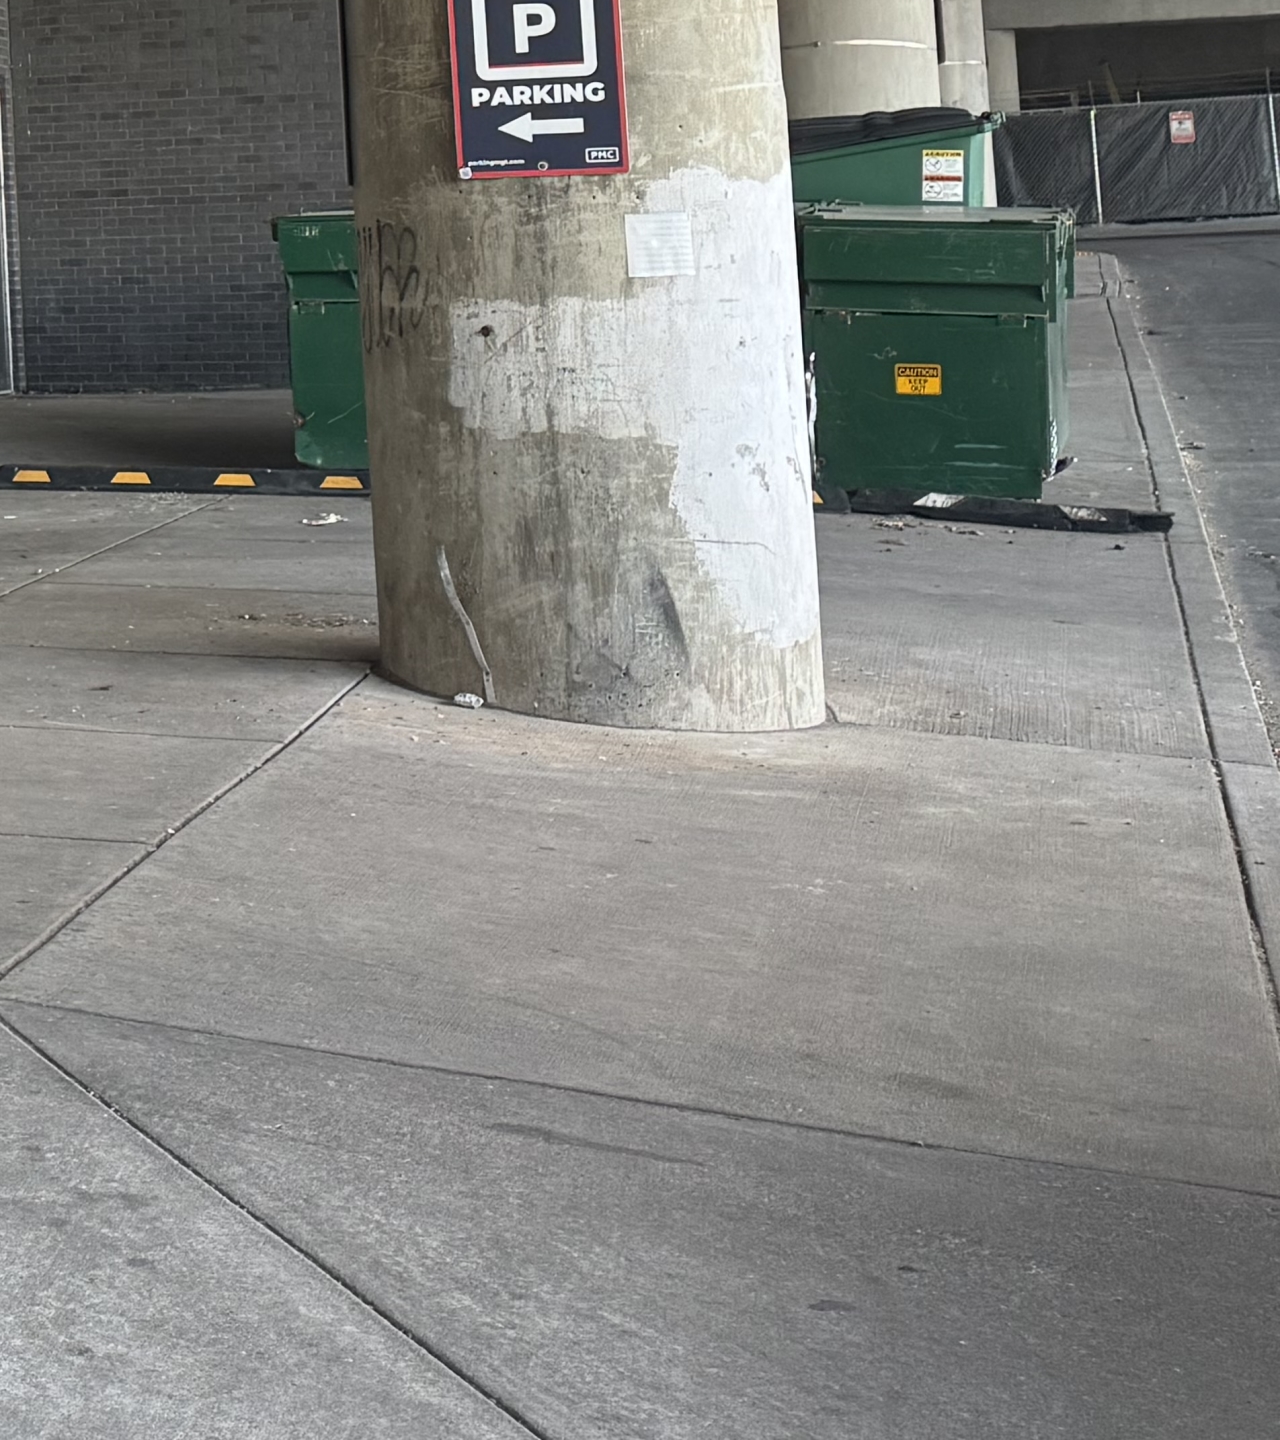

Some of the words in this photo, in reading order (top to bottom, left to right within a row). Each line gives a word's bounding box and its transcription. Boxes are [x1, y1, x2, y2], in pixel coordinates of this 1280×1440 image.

[512, 2, 557, 54] P
[471, 81, 606, 107] PARKING
[590, 150, 615, 159] PMC
[898, 368, 938, 376] CAUTION
